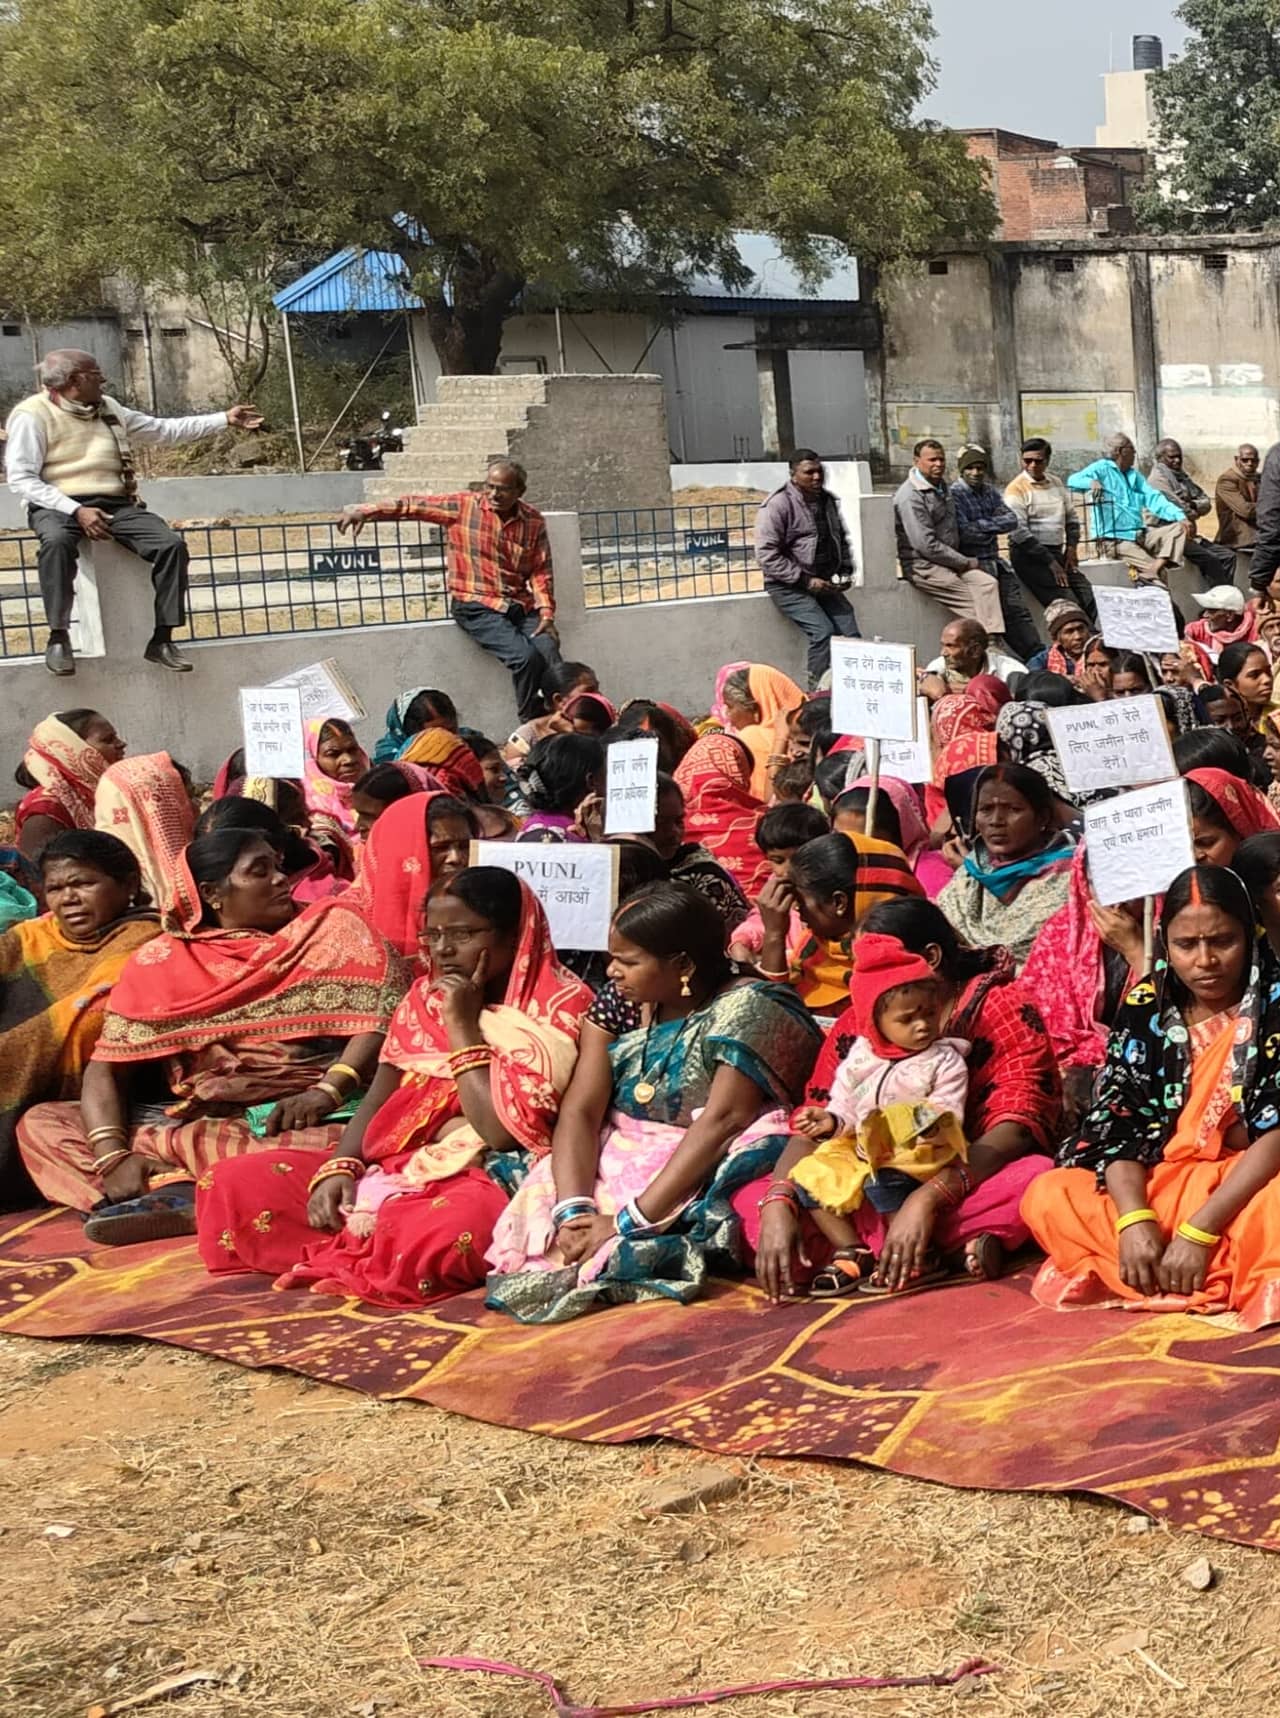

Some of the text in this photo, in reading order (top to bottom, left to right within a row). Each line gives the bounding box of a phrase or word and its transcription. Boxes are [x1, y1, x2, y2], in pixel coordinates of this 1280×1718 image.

[685, 533, 726, 551] PVUNL
[312, 553, 379, 571] PVUNL
[1065, 719, 1099, 733] PVUNL
[514, 860, 583, 880] PVUNL
